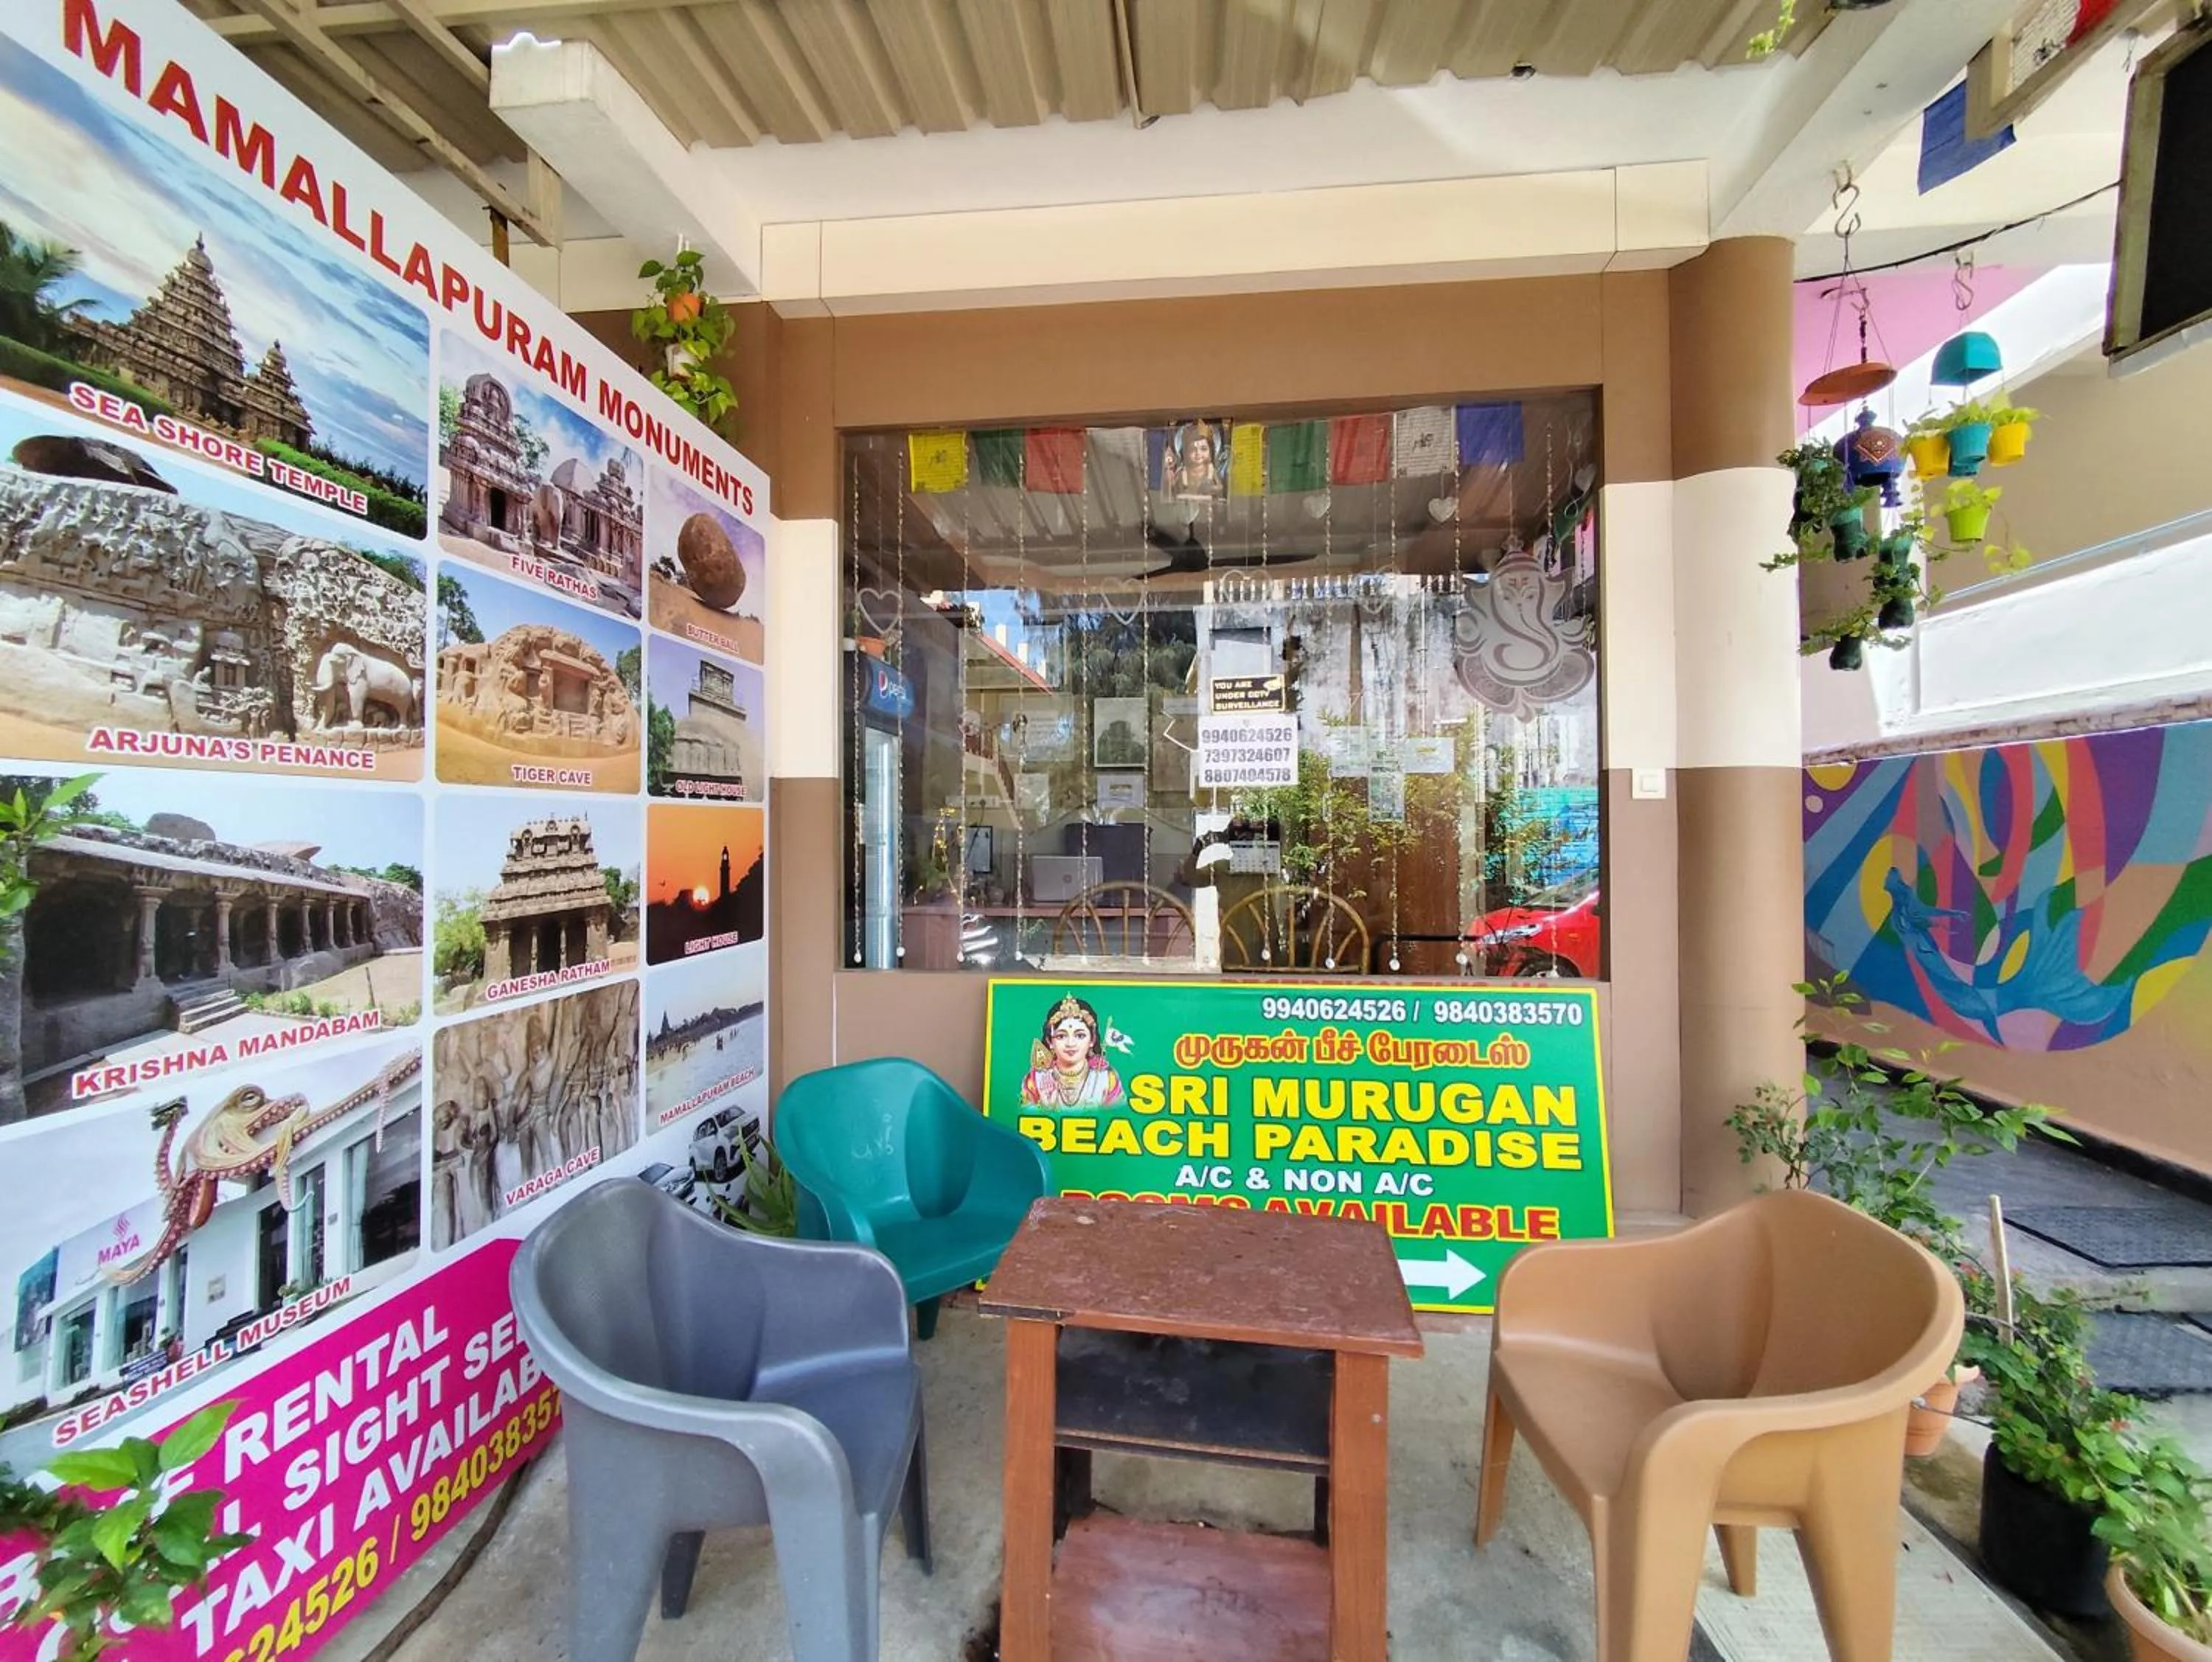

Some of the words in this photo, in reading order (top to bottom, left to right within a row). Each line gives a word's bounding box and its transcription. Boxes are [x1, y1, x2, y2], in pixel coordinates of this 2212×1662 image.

[63, 0, 587, 403] MAMALLAPURAM
[599, 379, 754, 515] MONUMENTS
[72, 383, 147, 432] SEA
[155, 417, 262, 474] SHORE
[268, 459, 367, 513] TEMPLE
[511, 555, 543, 580] FIVE
[546, 569, 597, 599] RATHAS
[1214, 700, 1280, 709] SURVEILLANCE
[1215, 691, 1245, 700] UNDER
[1248, 689, 1270, 698] CCTV
[88, 729, 252, 760] ARJUNA'S
[260, 744, 375, 769] PENANCE
[1202, 728, 1293, 743] 9940624526
[1204, 748, 1291, 763] 7397324607
[512, 765, 555, 783] TIGER
[558, 770, 591, 785] CAVE
[1204, 768, 1291, 783] 8807404578
[684, 936, 711, 954] LIGHT
[712, 931, 738, 948] HOUSE
[486, 971, 557, 1000] GANESHA
[559, 961, 611, 983] RATHAM
[1262, 997, 1407, 1023] 9940624526
[1413, 1000, 1420, 1023] /
[1433, 999, 1582, 1025] 9840383570
[74, 1043, 228, 1097] KRISHNA
[239, 1010, 380, 1059] MANDABAM
[1174, 1027, 1307, 1068] முருகன்
[1312, 1026, 1363, 1064] பீச்
[660, 1080, 730, 1124] MAMALLAPURAM
[730, 1068, 755, 1088] BEACH
[1129, 1074, 1228, 1116] SRI
[1253, 1078, 1577, 1126] MURUGAN
[1018, 1116, 1230, 1158] BEACH
[1254, 1124, 1583, 1170] PARADISE
[505, 1167, 563, 1206] VARAGA
[566, 1147, 600, 1174] CAVE
[1175, 1165, 1232, 1188] A/C
[1245, 1167, 1270, 1189] &
[1284, 1169, 1363, 1195] NON
[1374, 1172, 1435, 1196] A/C
[97, 1233, 141, 1265] MAYA
[53, 1341, 232, 1446] SEASHELL
[238, 1276, 352, 1350] MUSEUM
[224, 1305, 448, 1484] RENTAL
[283, 1355, 451, 1511] SIGHT
[463, 1312, 525, 1380] SE
[181, 1502, 334, 1658] TAXI
[354, 1352, 543, 1532] AVAILAB
[389, 1514, 400, 1565] /
